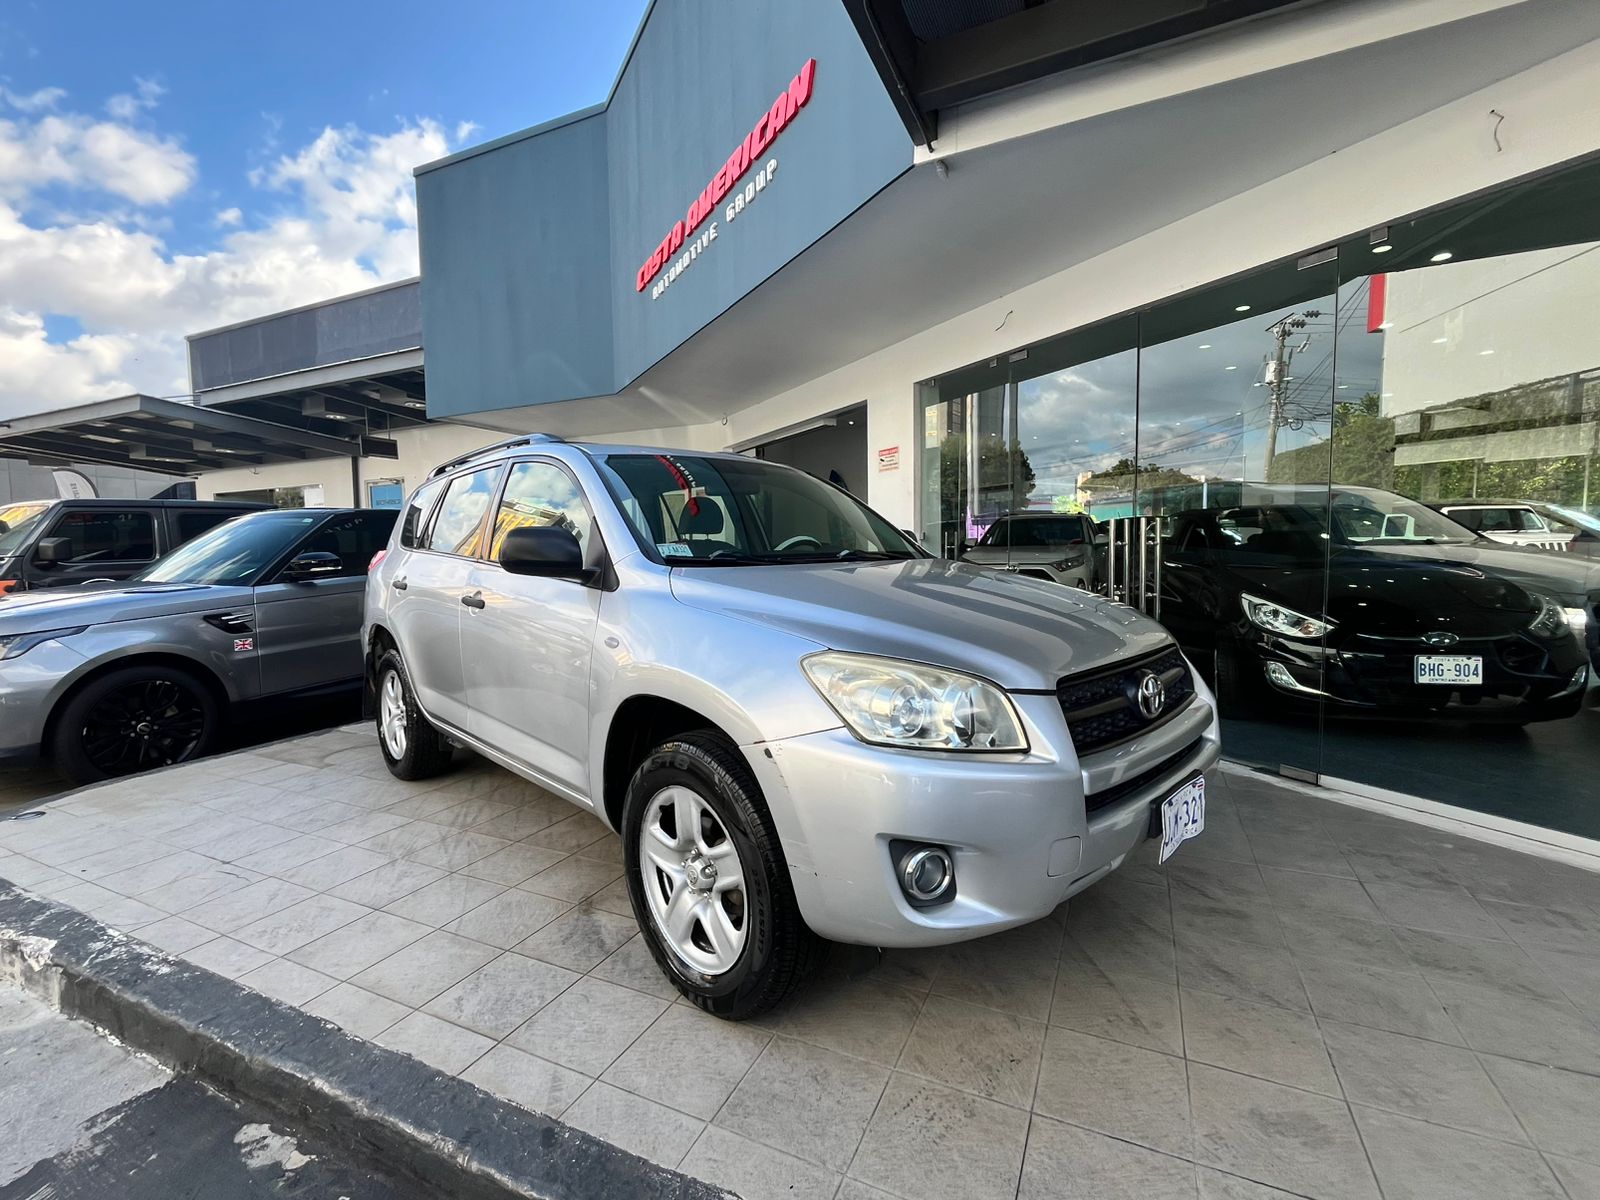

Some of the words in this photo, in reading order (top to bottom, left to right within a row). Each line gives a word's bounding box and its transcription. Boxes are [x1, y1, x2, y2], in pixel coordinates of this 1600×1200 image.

[636, 219, 686, 293] COSTA
[685, 57, 816, 237] AMERICAN
[651, 221, 719, 300] AUTOMOTIVE
[725, 158, 778, 223] GROUP
[1419, 663, 1480, 678] BHG-904
